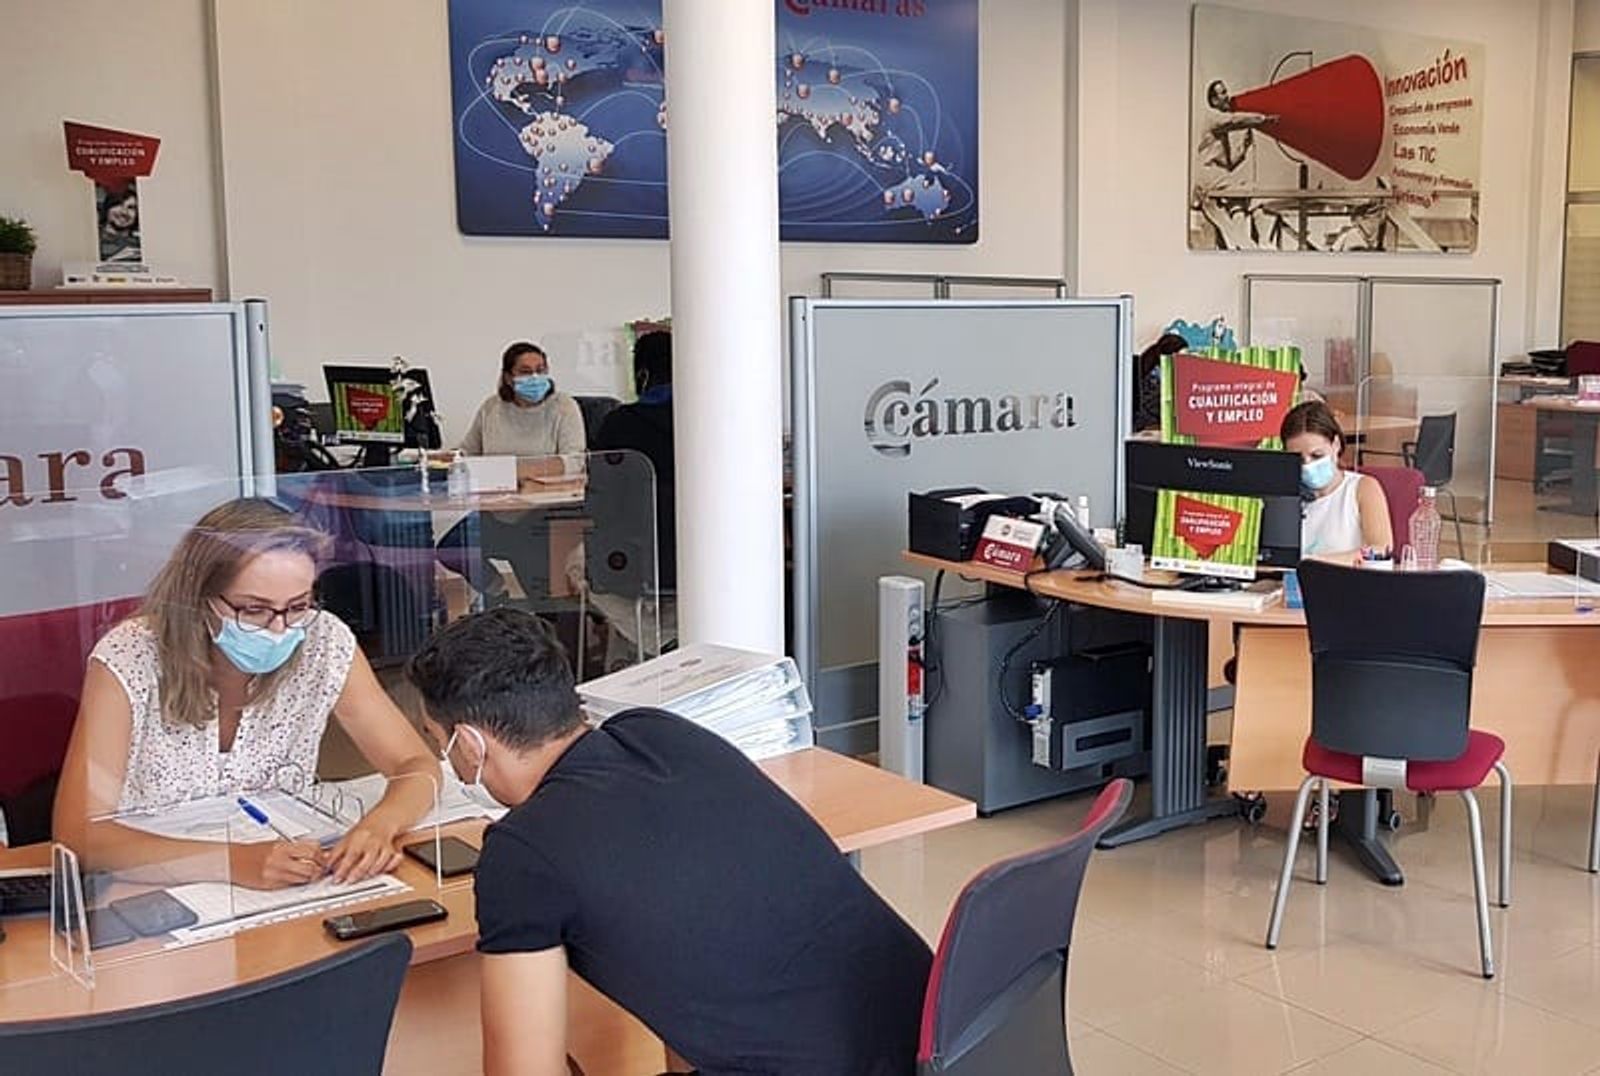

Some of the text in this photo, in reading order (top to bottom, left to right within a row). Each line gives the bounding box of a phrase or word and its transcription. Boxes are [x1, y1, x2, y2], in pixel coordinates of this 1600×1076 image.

[1384, 48, 1467, 97] Innovación
[1392, 120, 1435, 135] Economía
[1393, 141, 1436, 163] Las TIC
[1188, 390, 1278, 409] CUALIFICACIÓN
[1206, 408, 1264, 424] Y EMPLEO
[1187, 456, 1233, 470] ViewSonic
